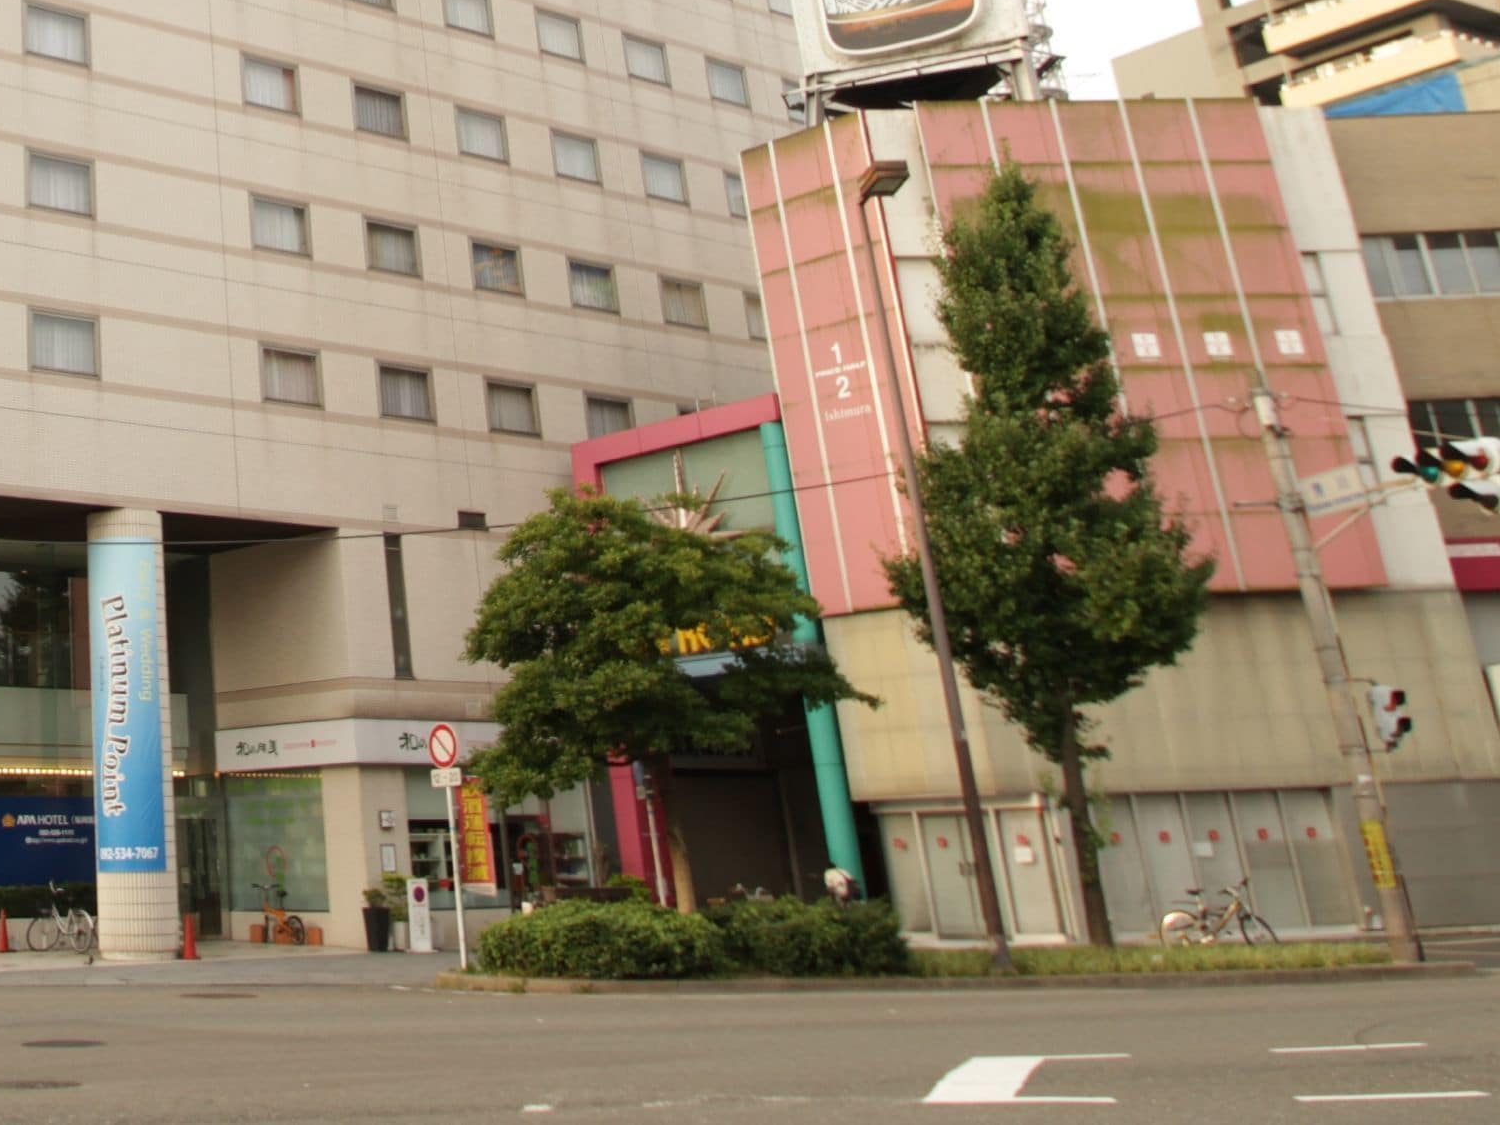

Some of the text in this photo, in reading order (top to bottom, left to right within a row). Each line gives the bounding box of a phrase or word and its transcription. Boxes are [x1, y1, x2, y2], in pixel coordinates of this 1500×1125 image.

[836, 376, 852, 399] 2
[101, 594, 130, 817] Platinum Point
[37, 815, 69, 825] HOTEL
